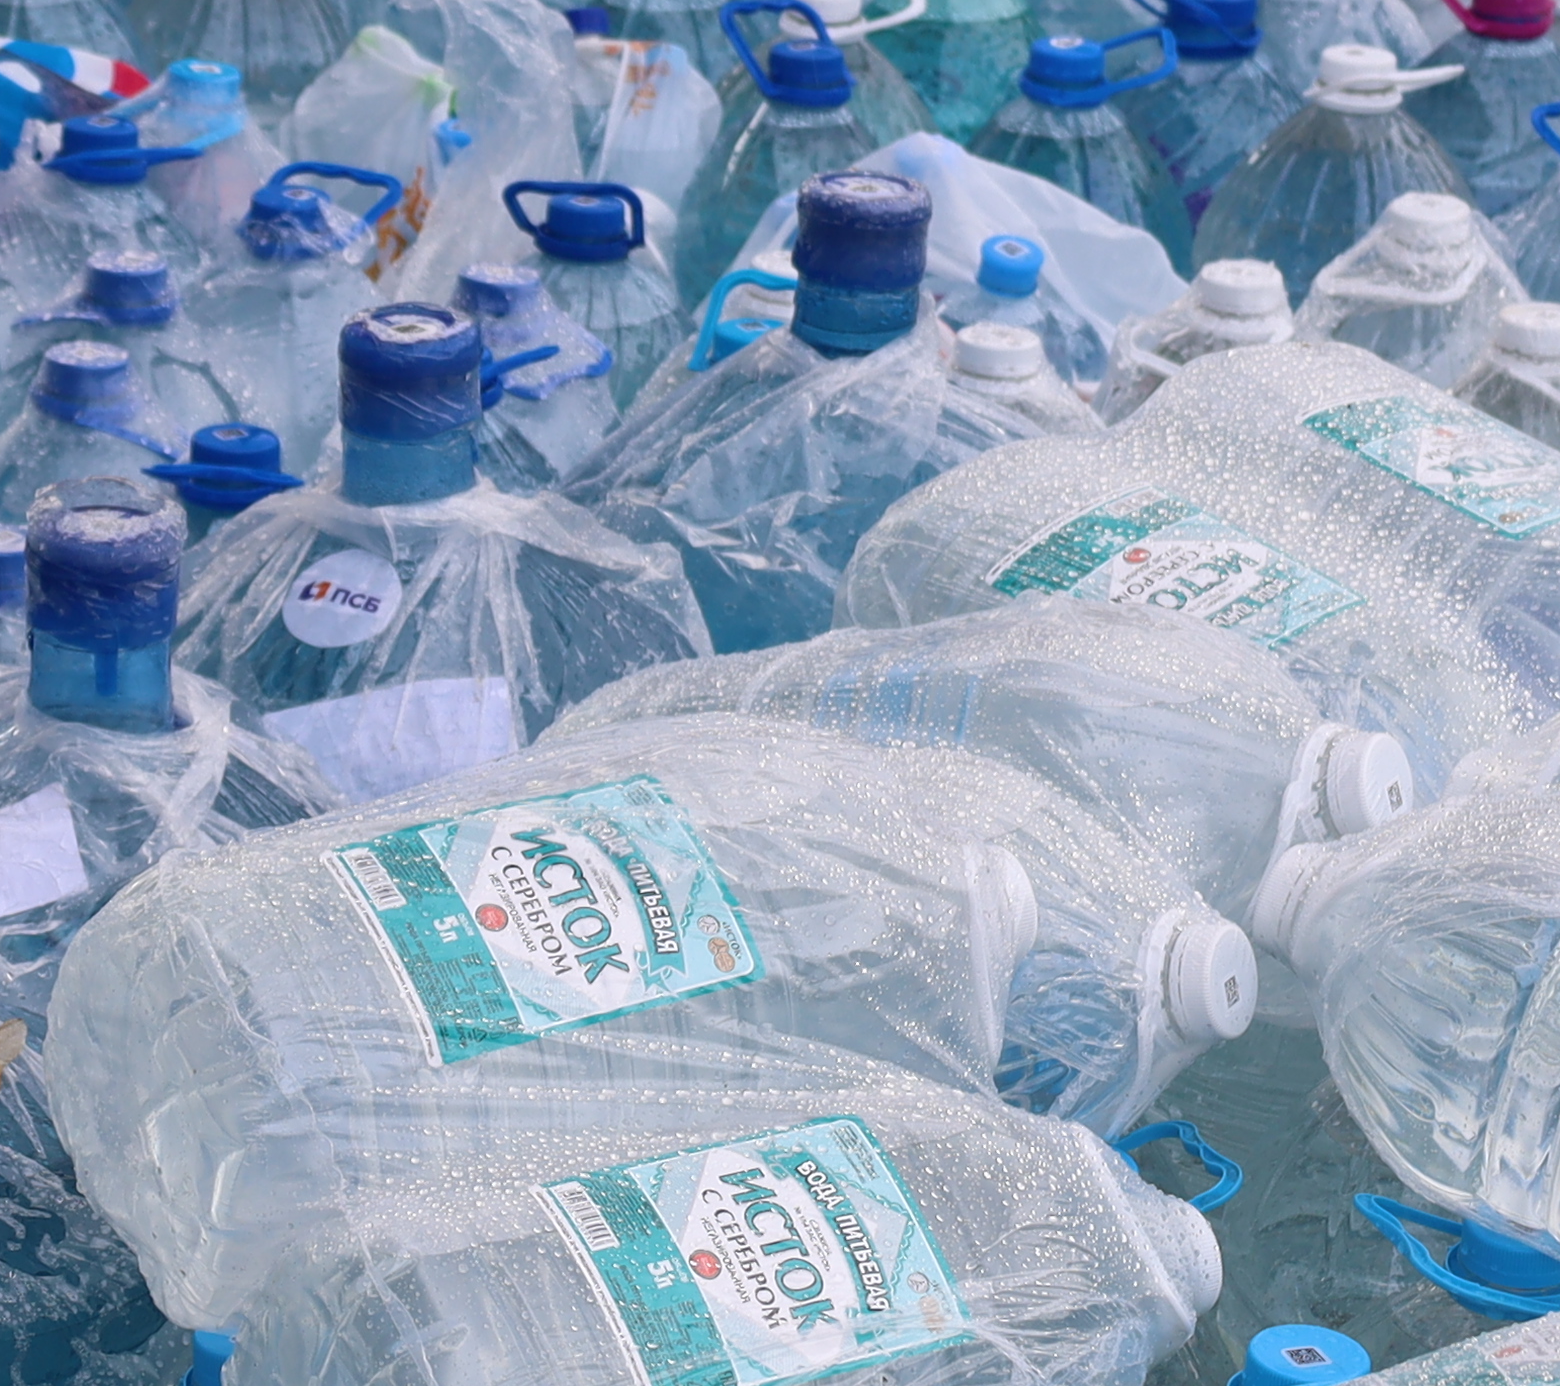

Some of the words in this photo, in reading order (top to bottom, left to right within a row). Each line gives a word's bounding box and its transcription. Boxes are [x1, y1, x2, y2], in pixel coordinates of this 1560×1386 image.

[329, 587, 382, 613] ПСБ
[491, 846, 512, 861] С
[502, 864, 572, 976] СЕРЕБРОМ
[510, 826, 630, 985] ИСТОК
[628, 861, 680, 955] ПИТЬЕВАЯ
[701, 1189, 723, 1205] С
[713, 1209, 788, 1330] СЕРЕБРОМ
[719, 1166, 842, 1332] ИСТОК
[795, 1159, 845, 1211] ВОДА
[835, 1213, 891, 1312] ПИТЬЕВАЯ
